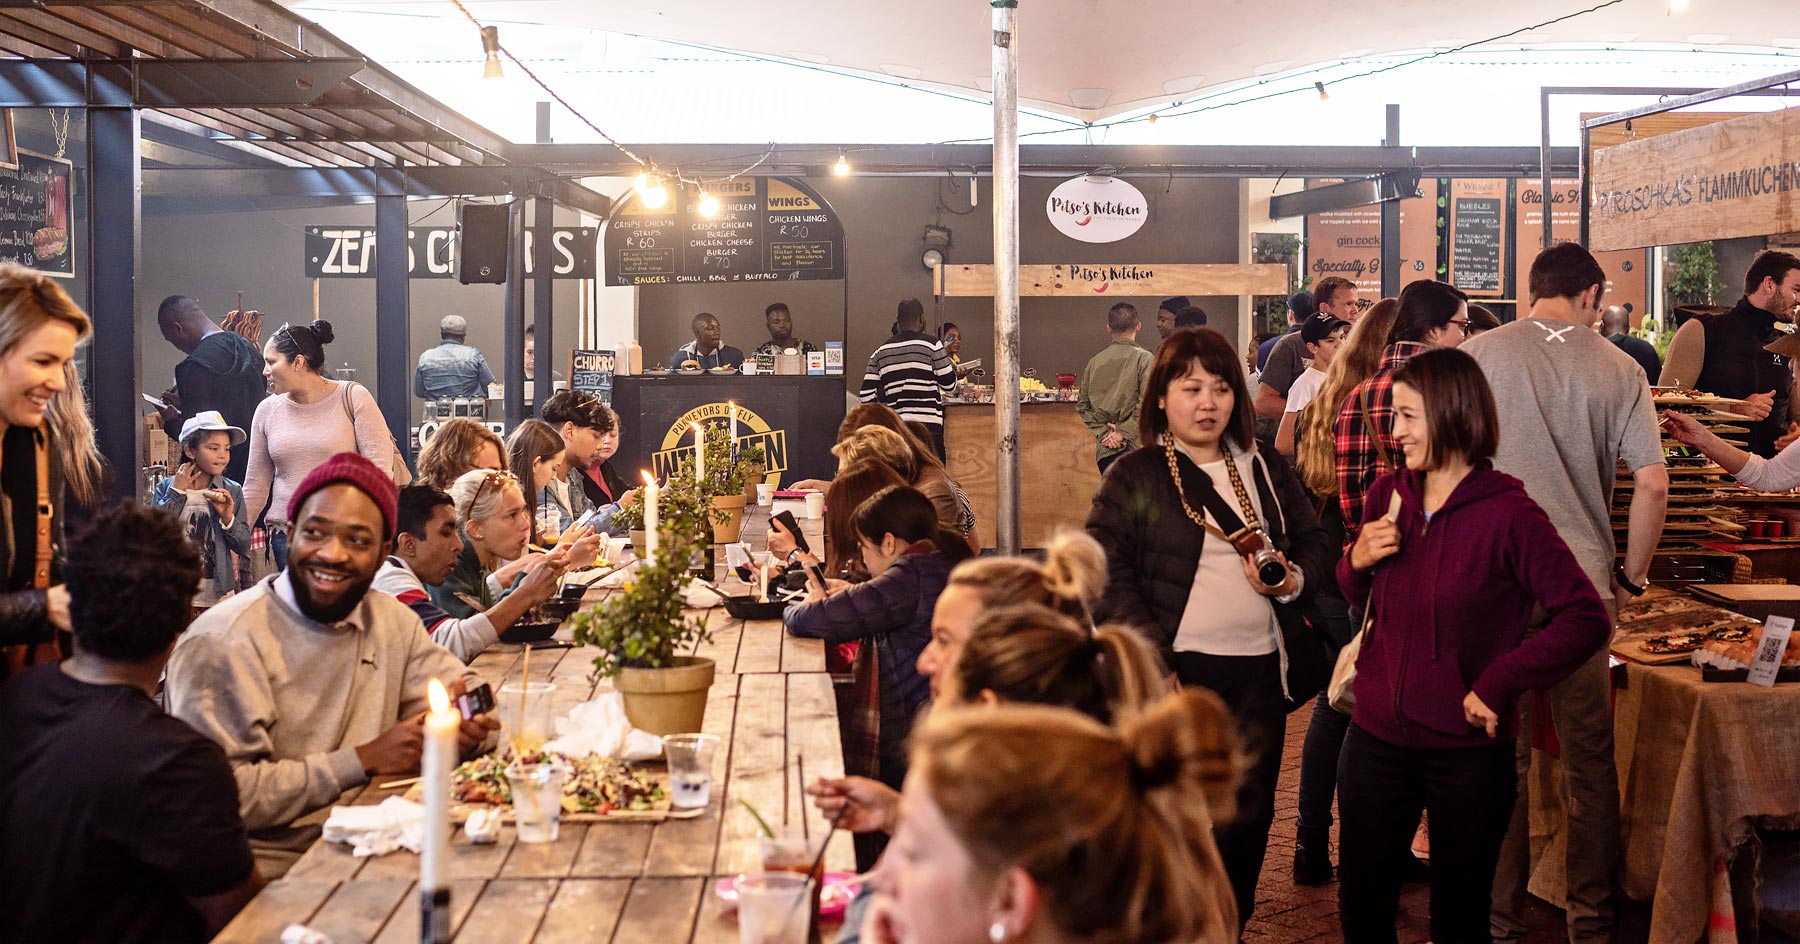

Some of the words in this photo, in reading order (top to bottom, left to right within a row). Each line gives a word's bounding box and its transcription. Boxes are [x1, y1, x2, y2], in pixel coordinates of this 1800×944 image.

[1700, 161, 1800, 203] FLAMMKUCHEN
[768, 197, 810, 206] WINGS
[1522, 189, 1564, 204] Claic
[1052, 197, 1090, 215] Pitso's
[1094, 201, 1142, 216] Kitchen
[614, 221, 640, 229] CRISPY
[768, 216, 801, 224] CHICKEN
[802, 214, 828, 222] WINGS
[780, 225, 788, 235] R
[791, 226, 808, 238] 50
[626, 237, 634, 248] R
[640, 238, 655, 248] 60
[1337, 236, 1352, 247] gin
[704, 256, 709, 264] R
[715, 257, 730, 268] 70
[1312, 258, 1365, 277] Specialty
[1070, 265, 1106, 281] Pitso's
[1110, 266, 1154, 280] Kitchen
[634, 276, 670, 284] SAUCES:
[574, 356, 615, 372] CHURRO
[574, 374, 600, 386] STEP
[600, 374, 610, 386] 1
[672, 405, 720, 436] PURVEYORS
[738, 409, 754, 422] FLY
